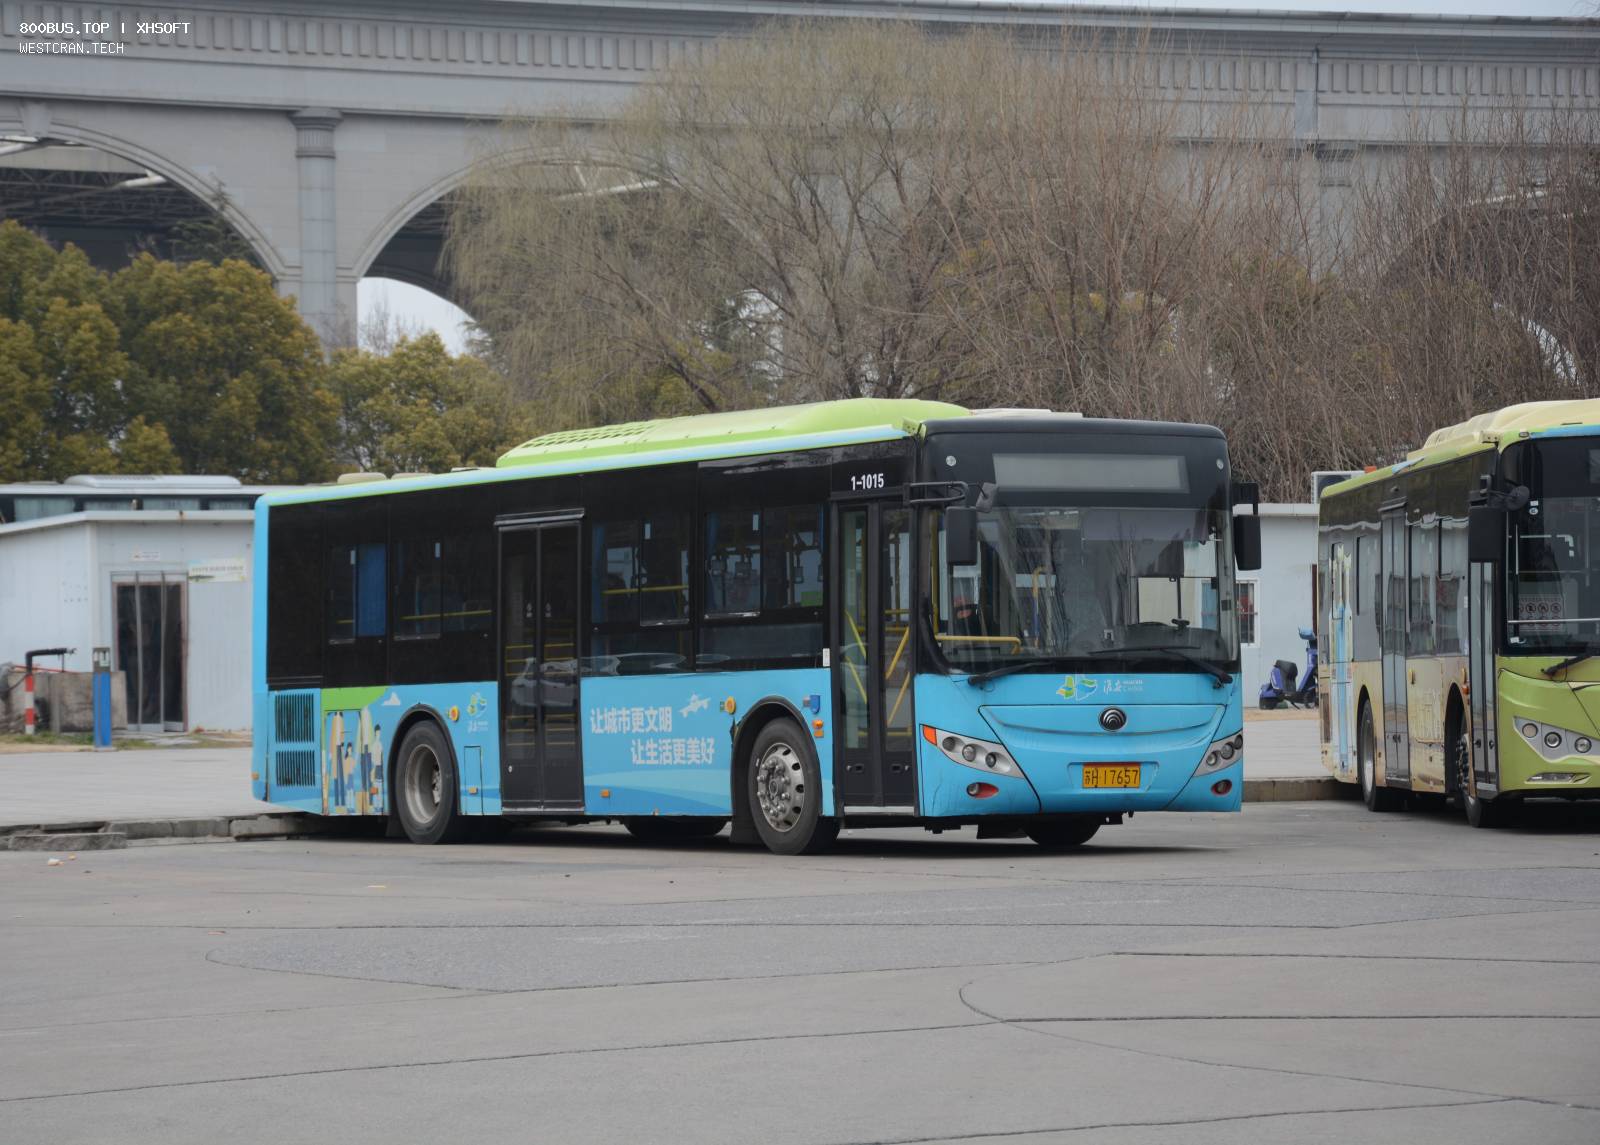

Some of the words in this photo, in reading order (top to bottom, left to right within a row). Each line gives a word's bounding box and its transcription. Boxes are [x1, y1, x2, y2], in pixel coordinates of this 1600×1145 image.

[850, 472, 885, 491] 1-1015
[590, 705, 673, 734] 让城市更文明
[630, 737, 715, 765] 让生活更美好
